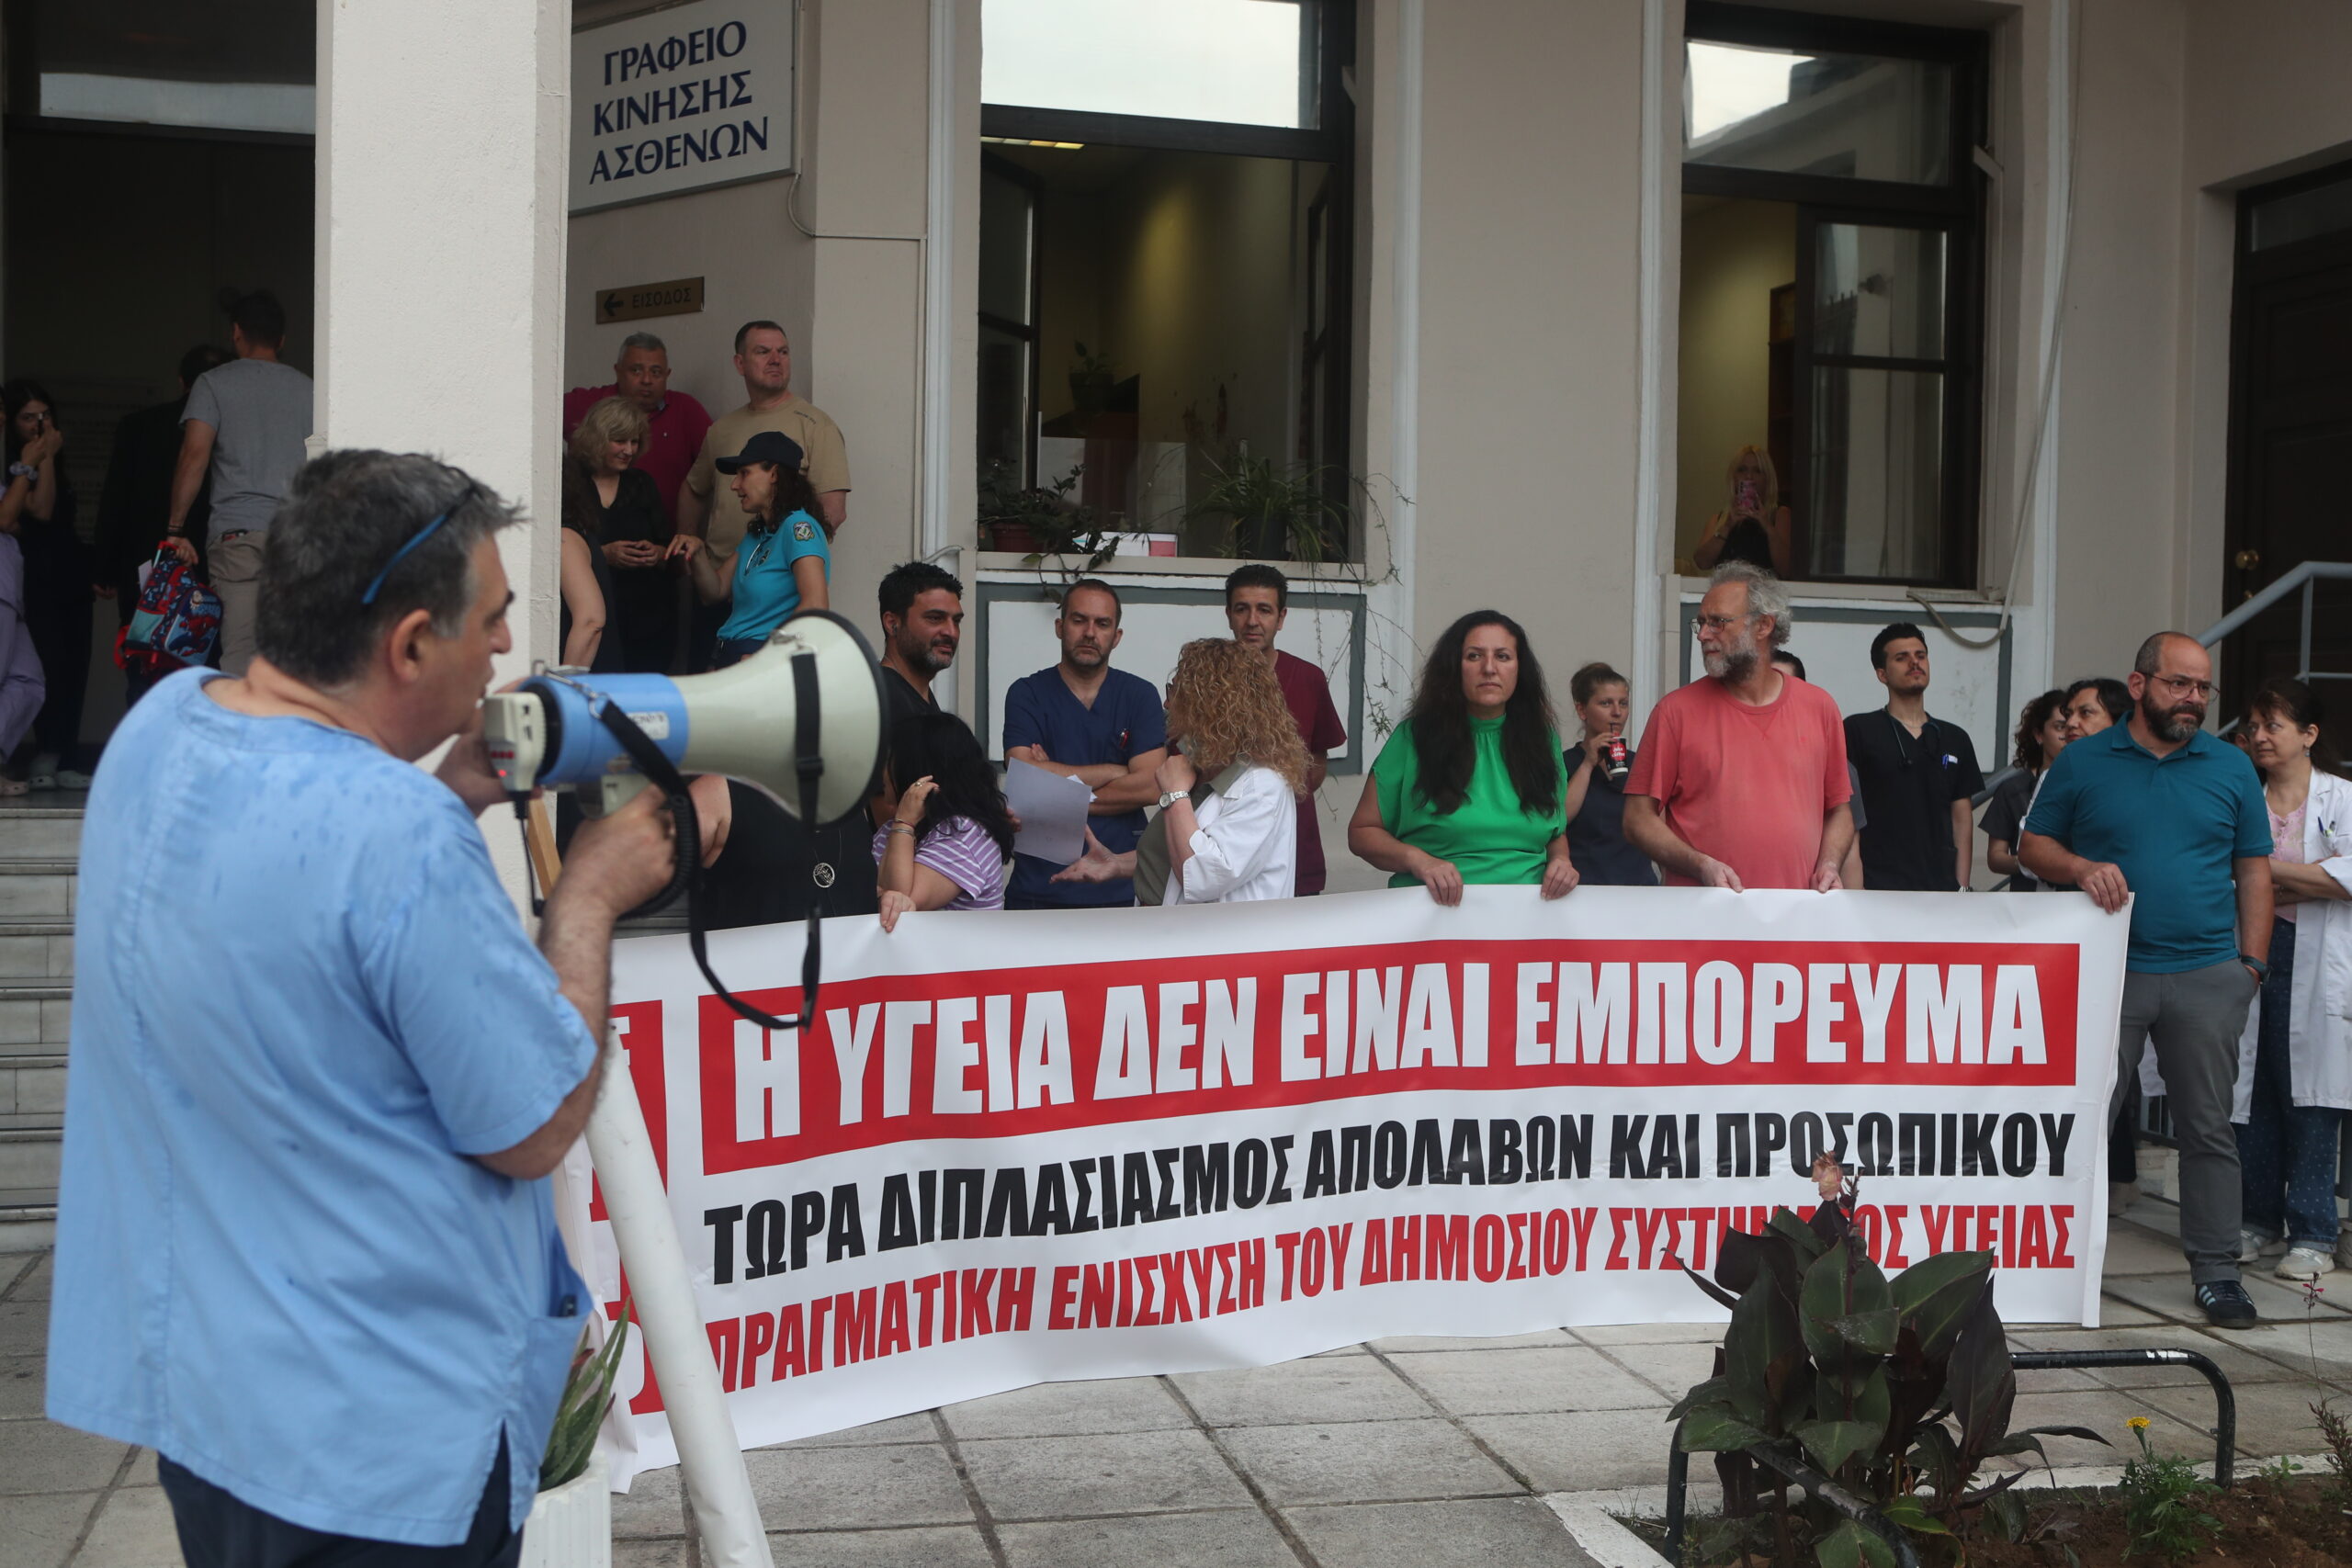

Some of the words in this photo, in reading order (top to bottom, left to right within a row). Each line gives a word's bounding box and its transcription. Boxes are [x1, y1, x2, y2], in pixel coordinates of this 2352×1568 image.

[604, 20, 747, 85] ΓΡΑΦΕΙΟ
[594, 70, 752, 136] ΚΙΝΗΣΗΣ
[589, 116, 768, 185] ΑΣΘΕΝΩΝ
[632, 287, 692, 309] ΕΙΣΟΔΟΣ
[733, 1013, 801, 1143] Η
[825, 991, 1075, 1126] ΥΓΕΙΑ
[1093, 976, 1257, 1100] ΔΕΝ
[1281, 962, 1490, 1082] ΕΙΝΑΙ
[1515, 960, 2048, 1066] ΕΜΠΟΡΕΥΜΑ
[704, 1182, 866, 1285] ΤΩΡΑ
[877, 1134, 1295, 1253] ΔΙΠΛΑΣΙΑΣΜΟΣ
[1302, 1114, 1594, 1200] ΑΠΟΛΑΒΩΝ
[1609, 1113, 1701, 1179] ΚΑΙ
[1715, 1111, 2075, 1179] ΠΡΟΣΩΠΙΚΟΥ
[705, 1267, 1036, 1393] ΠΡΑΓΜΑΤΙΚΗ
[1048, 1237, 1265, 1330] ΕΝΙΣΧΥΣΗ
[1275, 1223, 1353, 1302] ΤΟΥ
[1360, 1207, 1599, 1286] ΔΗΜΟΣΙΟΥ
[1605, 1204, 1908, 1271] ΣΥΣΤΟΣ
[1920, 1204, 2075, 1269] ΥΓΕΙΑΣ
